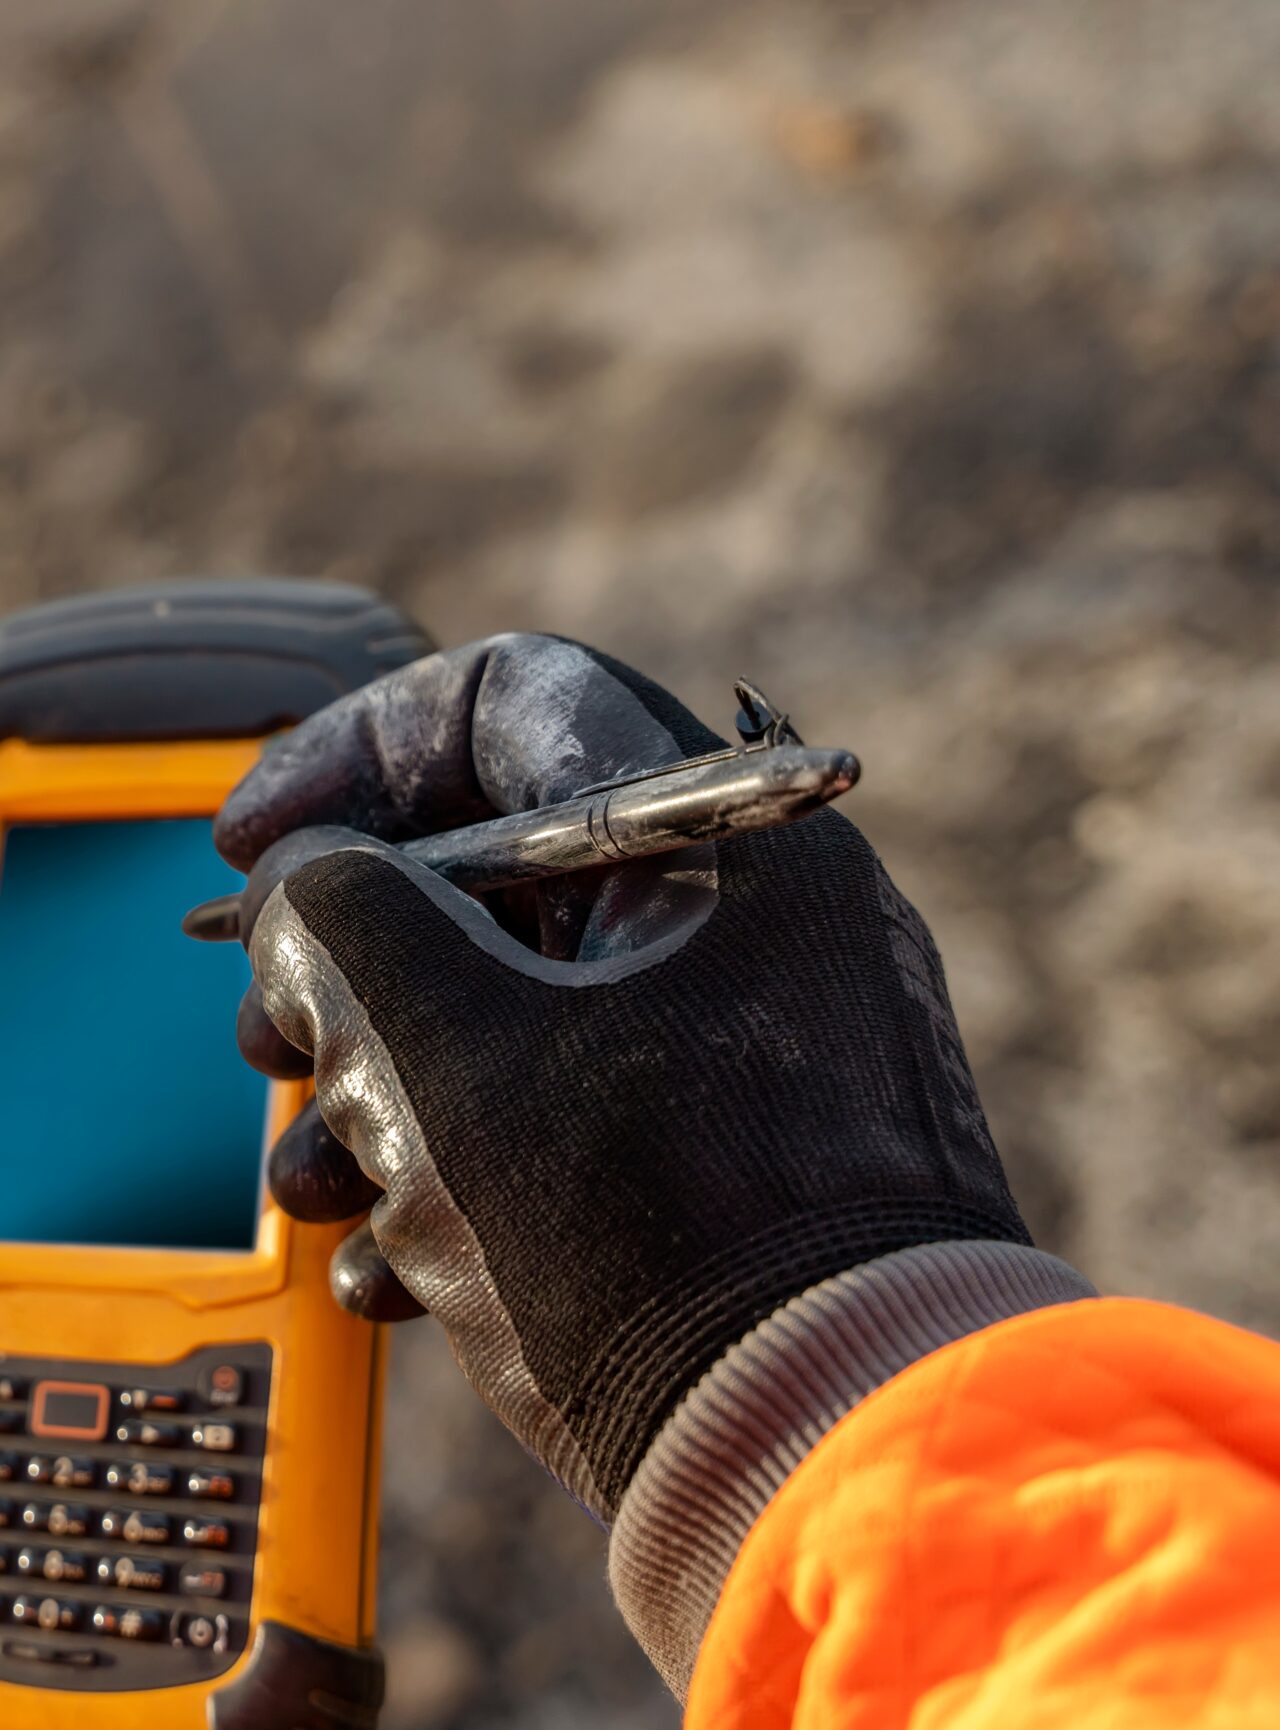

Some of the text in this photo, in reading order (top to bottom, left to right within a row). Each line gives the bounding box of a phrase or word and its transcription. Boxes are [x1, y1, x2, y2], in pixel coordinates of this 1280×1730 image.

[53, 1456, 73, 1487] 2
[128, 1463, 149, 1494] 3
[123, 1511, 144, 1543] 6
